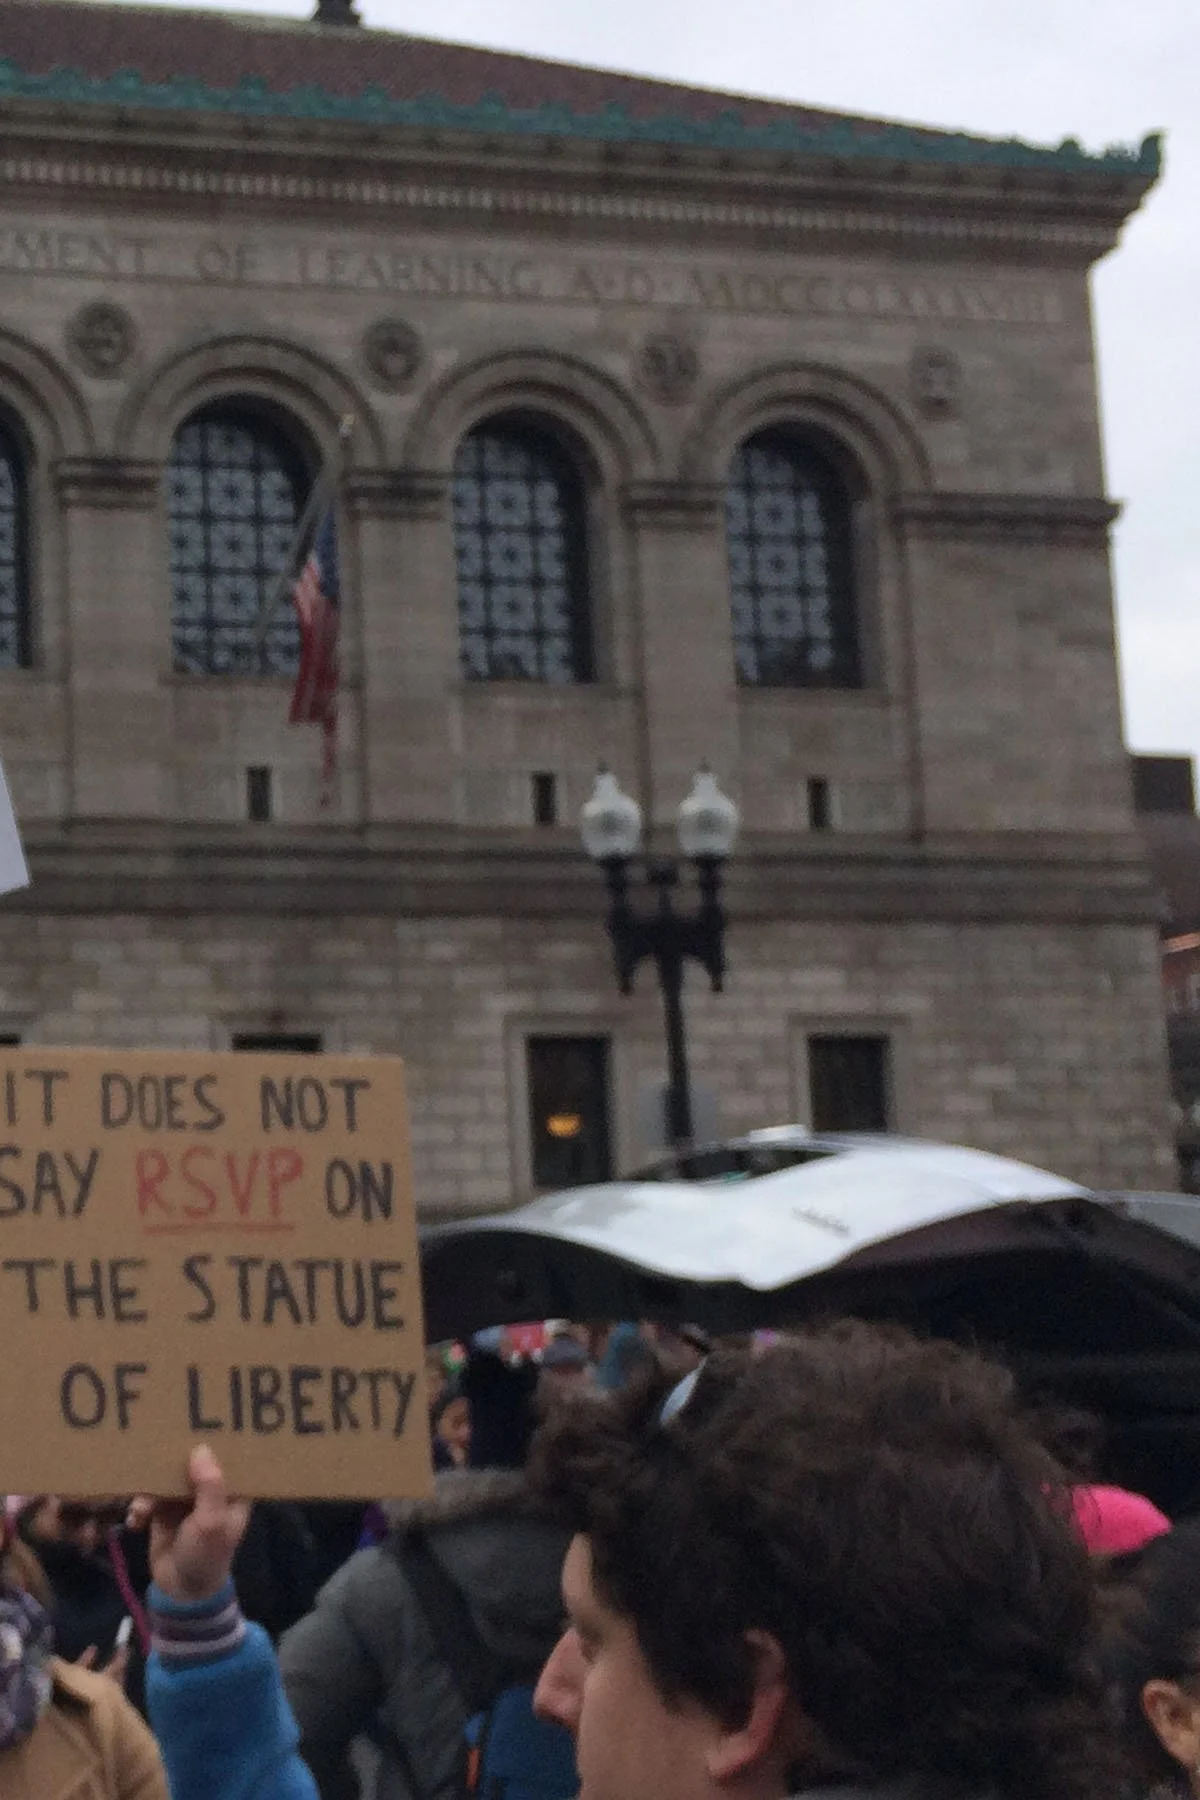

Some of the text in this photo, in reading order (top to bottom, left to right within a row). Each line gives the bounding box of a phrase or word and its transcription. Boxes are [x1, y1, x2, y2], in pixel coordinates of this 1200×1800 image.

[194, 239, 260, 281] OF
[302, 243, 542, 297] LEARNING
[4, 1069, 371, 1132] IT DOES NOT
[135, 1145, 305, 1222] RSVP
[324, 1157, 395, 1223] ON
[1, 1254, 405, 1330] THE STATUE
[60, 1361, 417, 1438] OF LIBERTY
